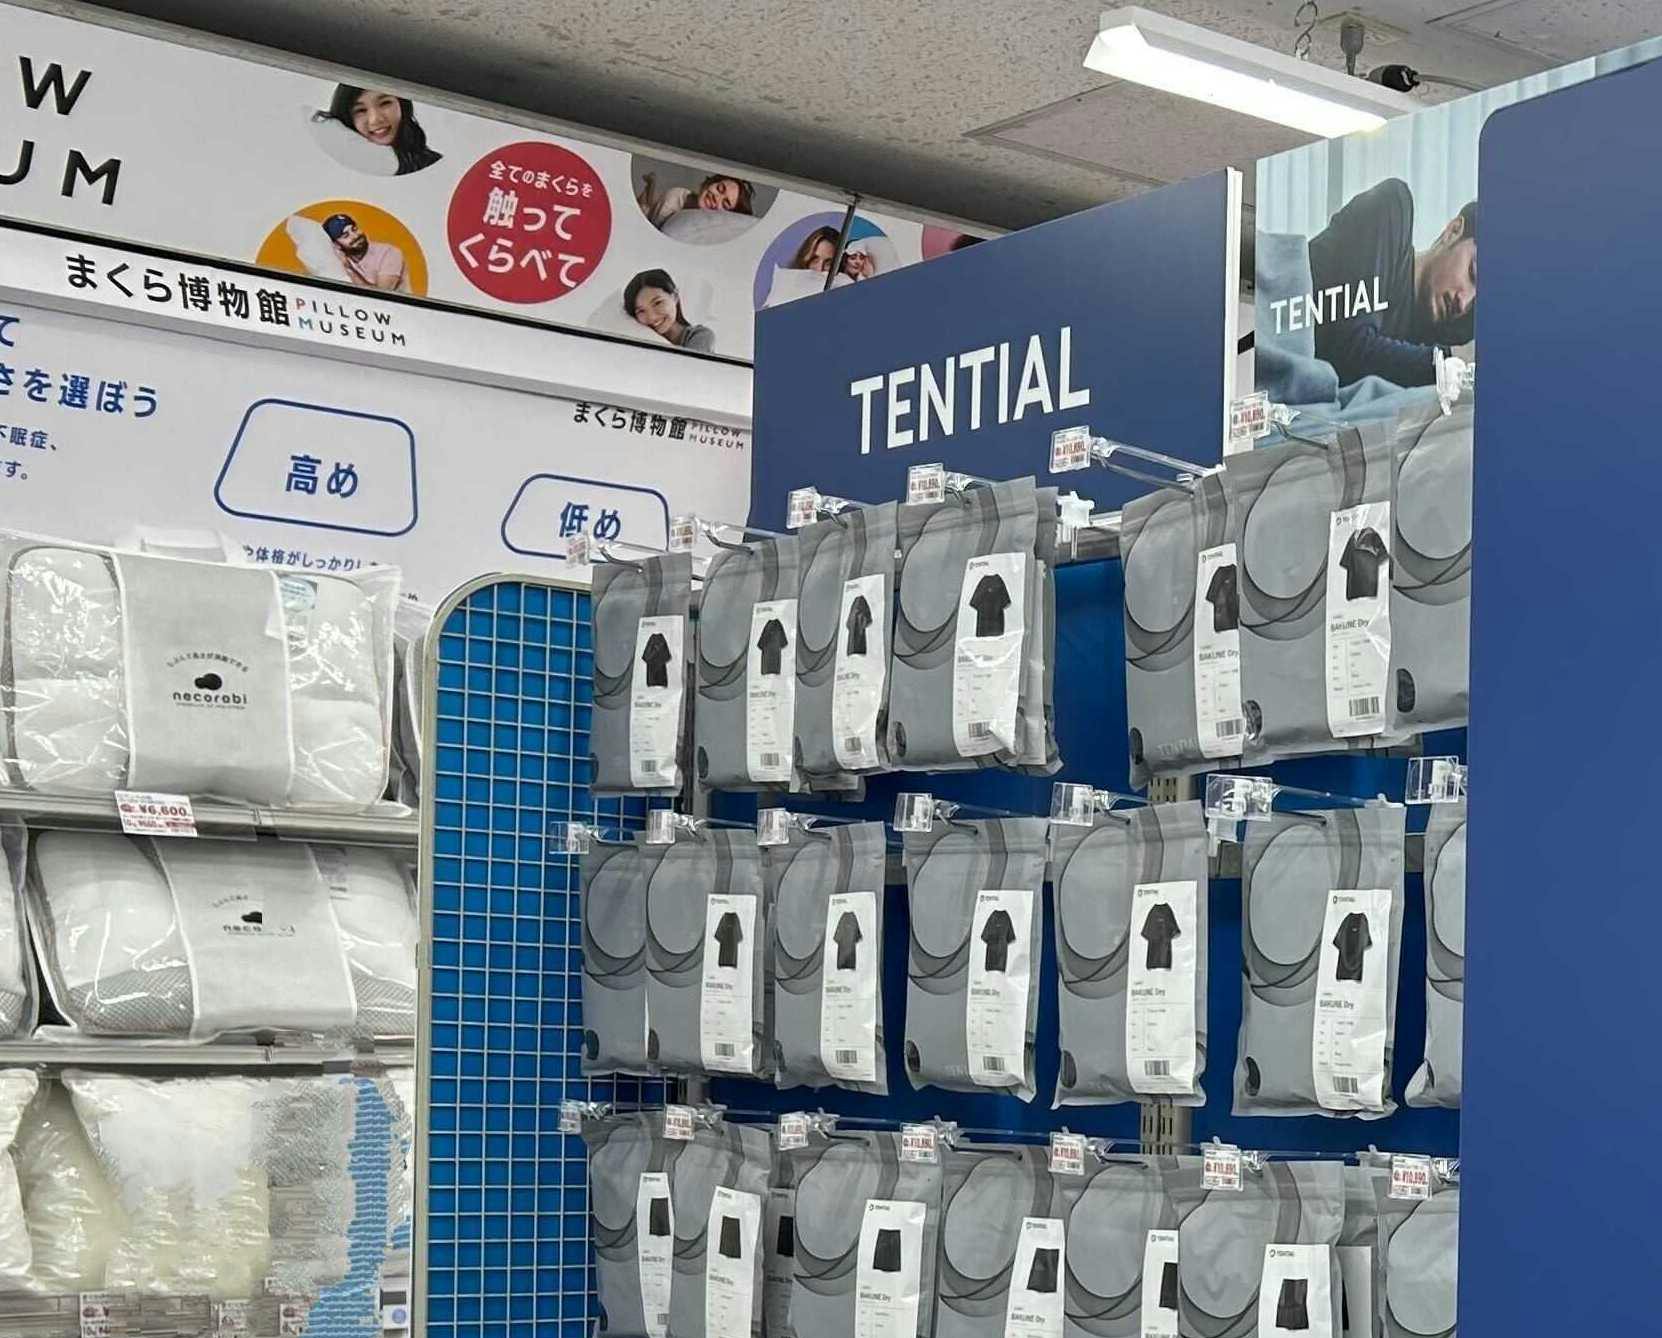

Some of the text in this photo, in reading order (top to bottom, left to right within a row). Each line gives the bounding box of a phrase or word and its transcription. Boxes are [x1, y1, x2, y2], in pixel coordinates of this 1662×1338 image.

[18, 55, 92, 116] W
[488, 160, 593, 198] 全てのまくらを
[482, 187, 582, 240] 触って
[458, 232, 585, 288] くらべて
[65, 254, 290, 328] まくら博物館
[296, 298, 392, 326] PILLOW
[1270, 276, 1389, 334] TENTIAL
[298, 316, 407, 347] MUSEUM
[850, 326, 1090, 455] TENTIAL
[573, 401, 688, 440] まくら博物館
[691, 422, 741, 438] PILLOW
[689, 434, 744, 450] MUSEUM
[285, 454, 359, 498] 高め
[559, 501, 621, 541] 低め
